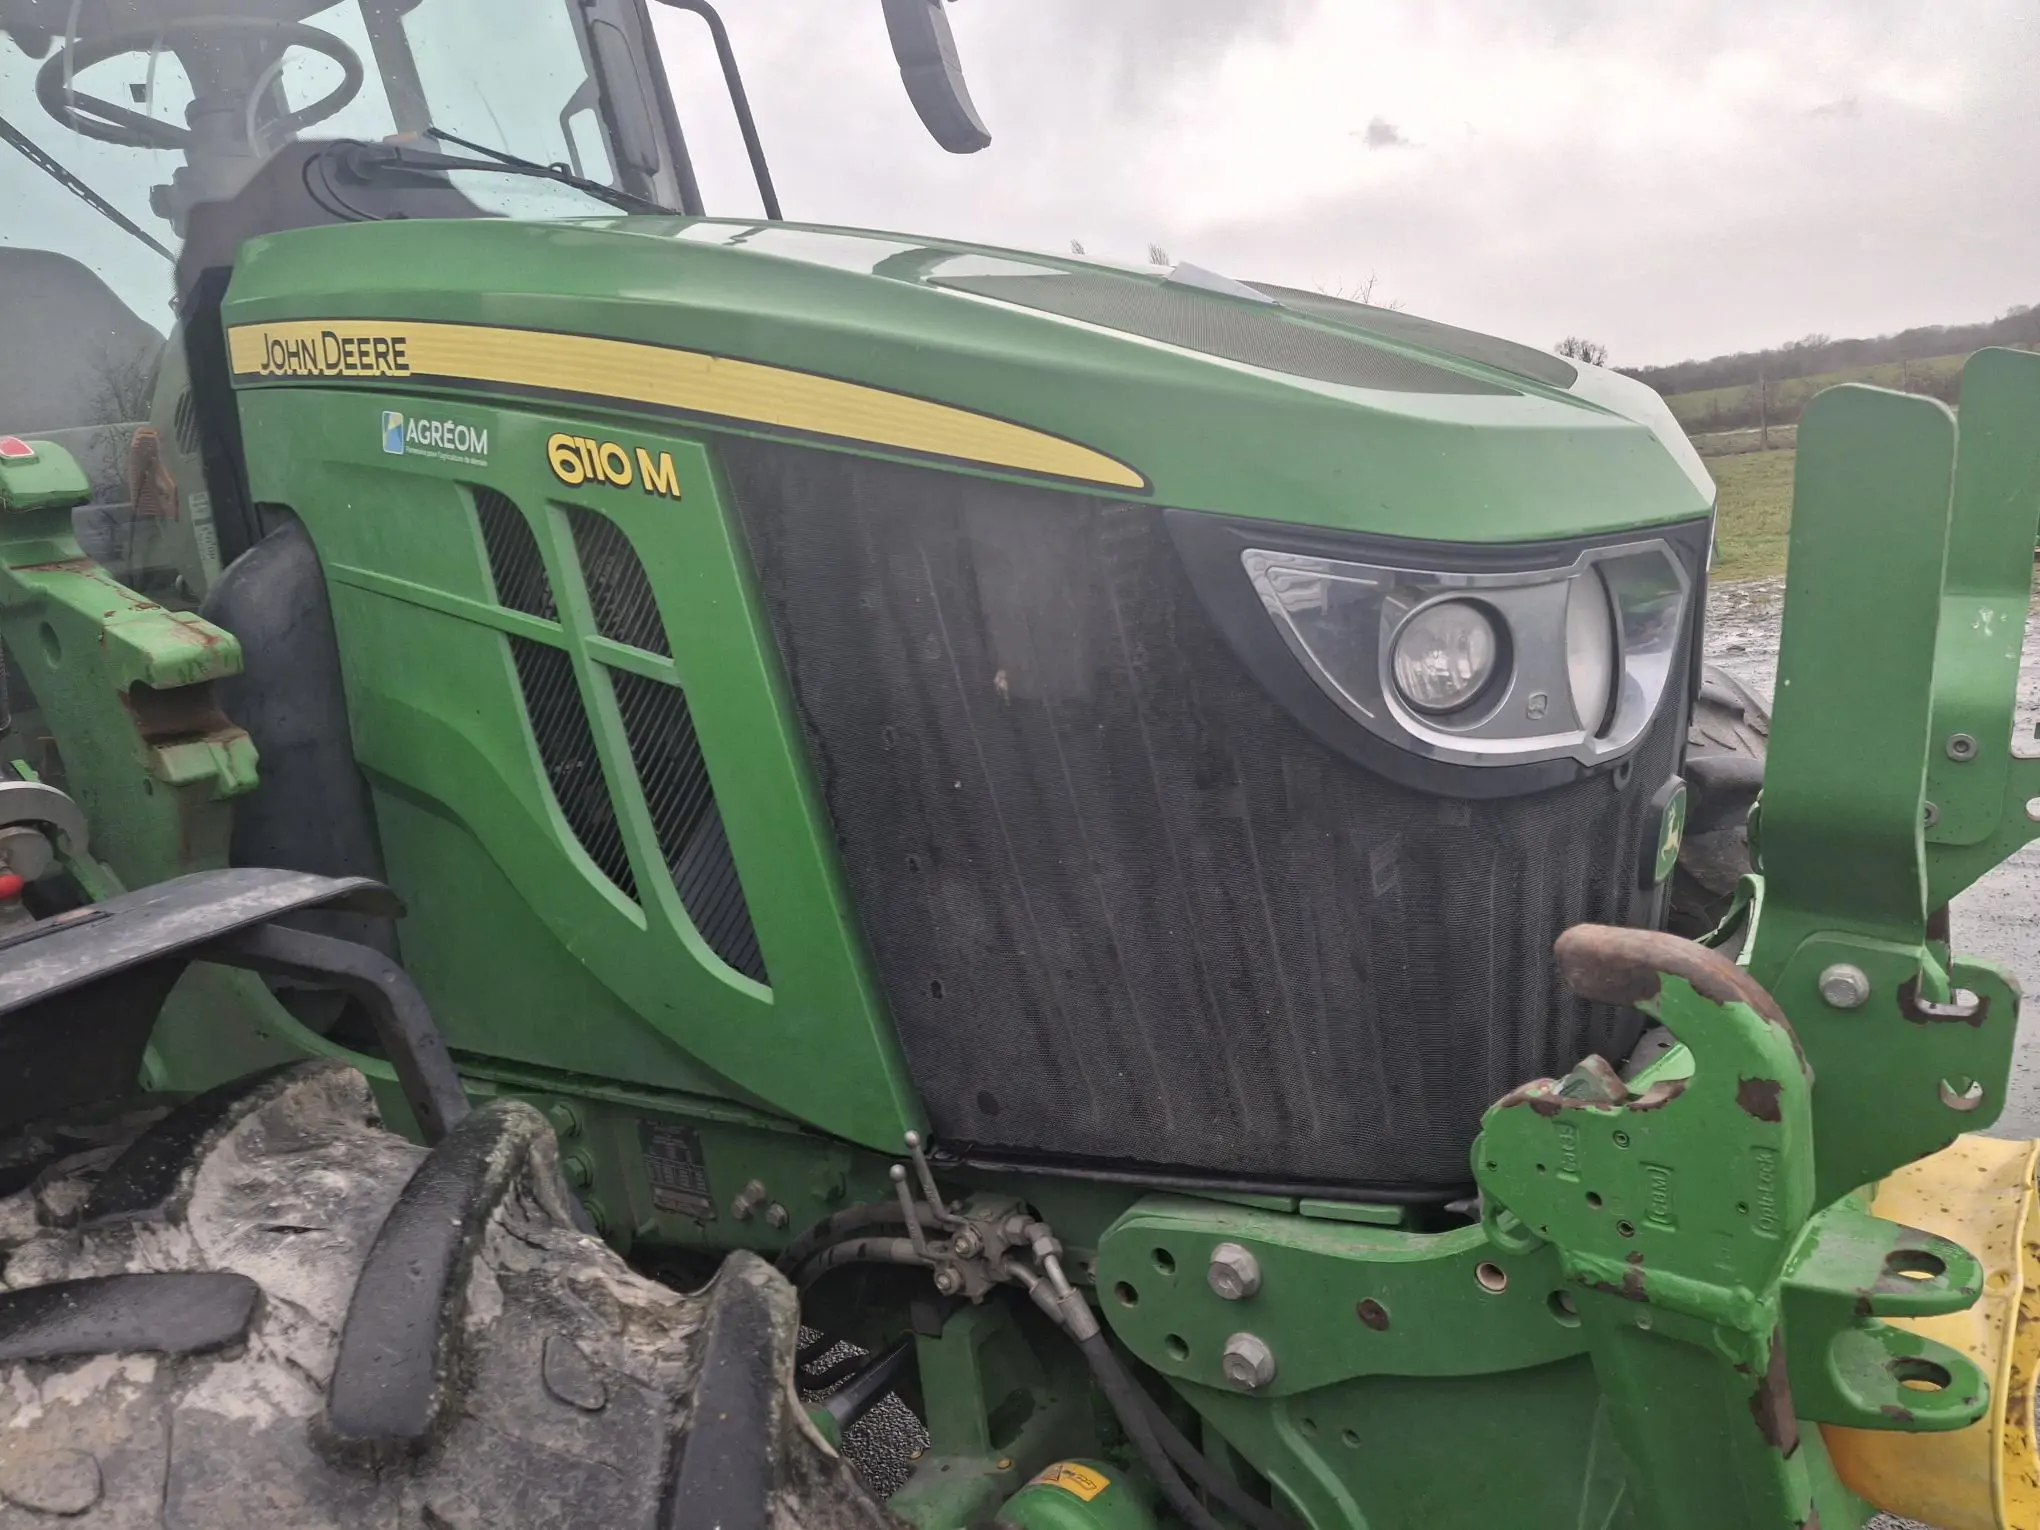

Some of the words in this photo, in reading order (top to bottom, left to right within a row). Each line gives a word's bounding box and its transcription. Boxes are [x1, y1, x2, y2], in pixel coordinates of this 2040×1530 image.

[260, 332, 319, 372] JOHN
[321, 330, 410, 373] DEERE
[405, 417, 488, 456] AGRÉOM
[547, 432, 633, 489] 6110
[635, 446, 682, 499] M
